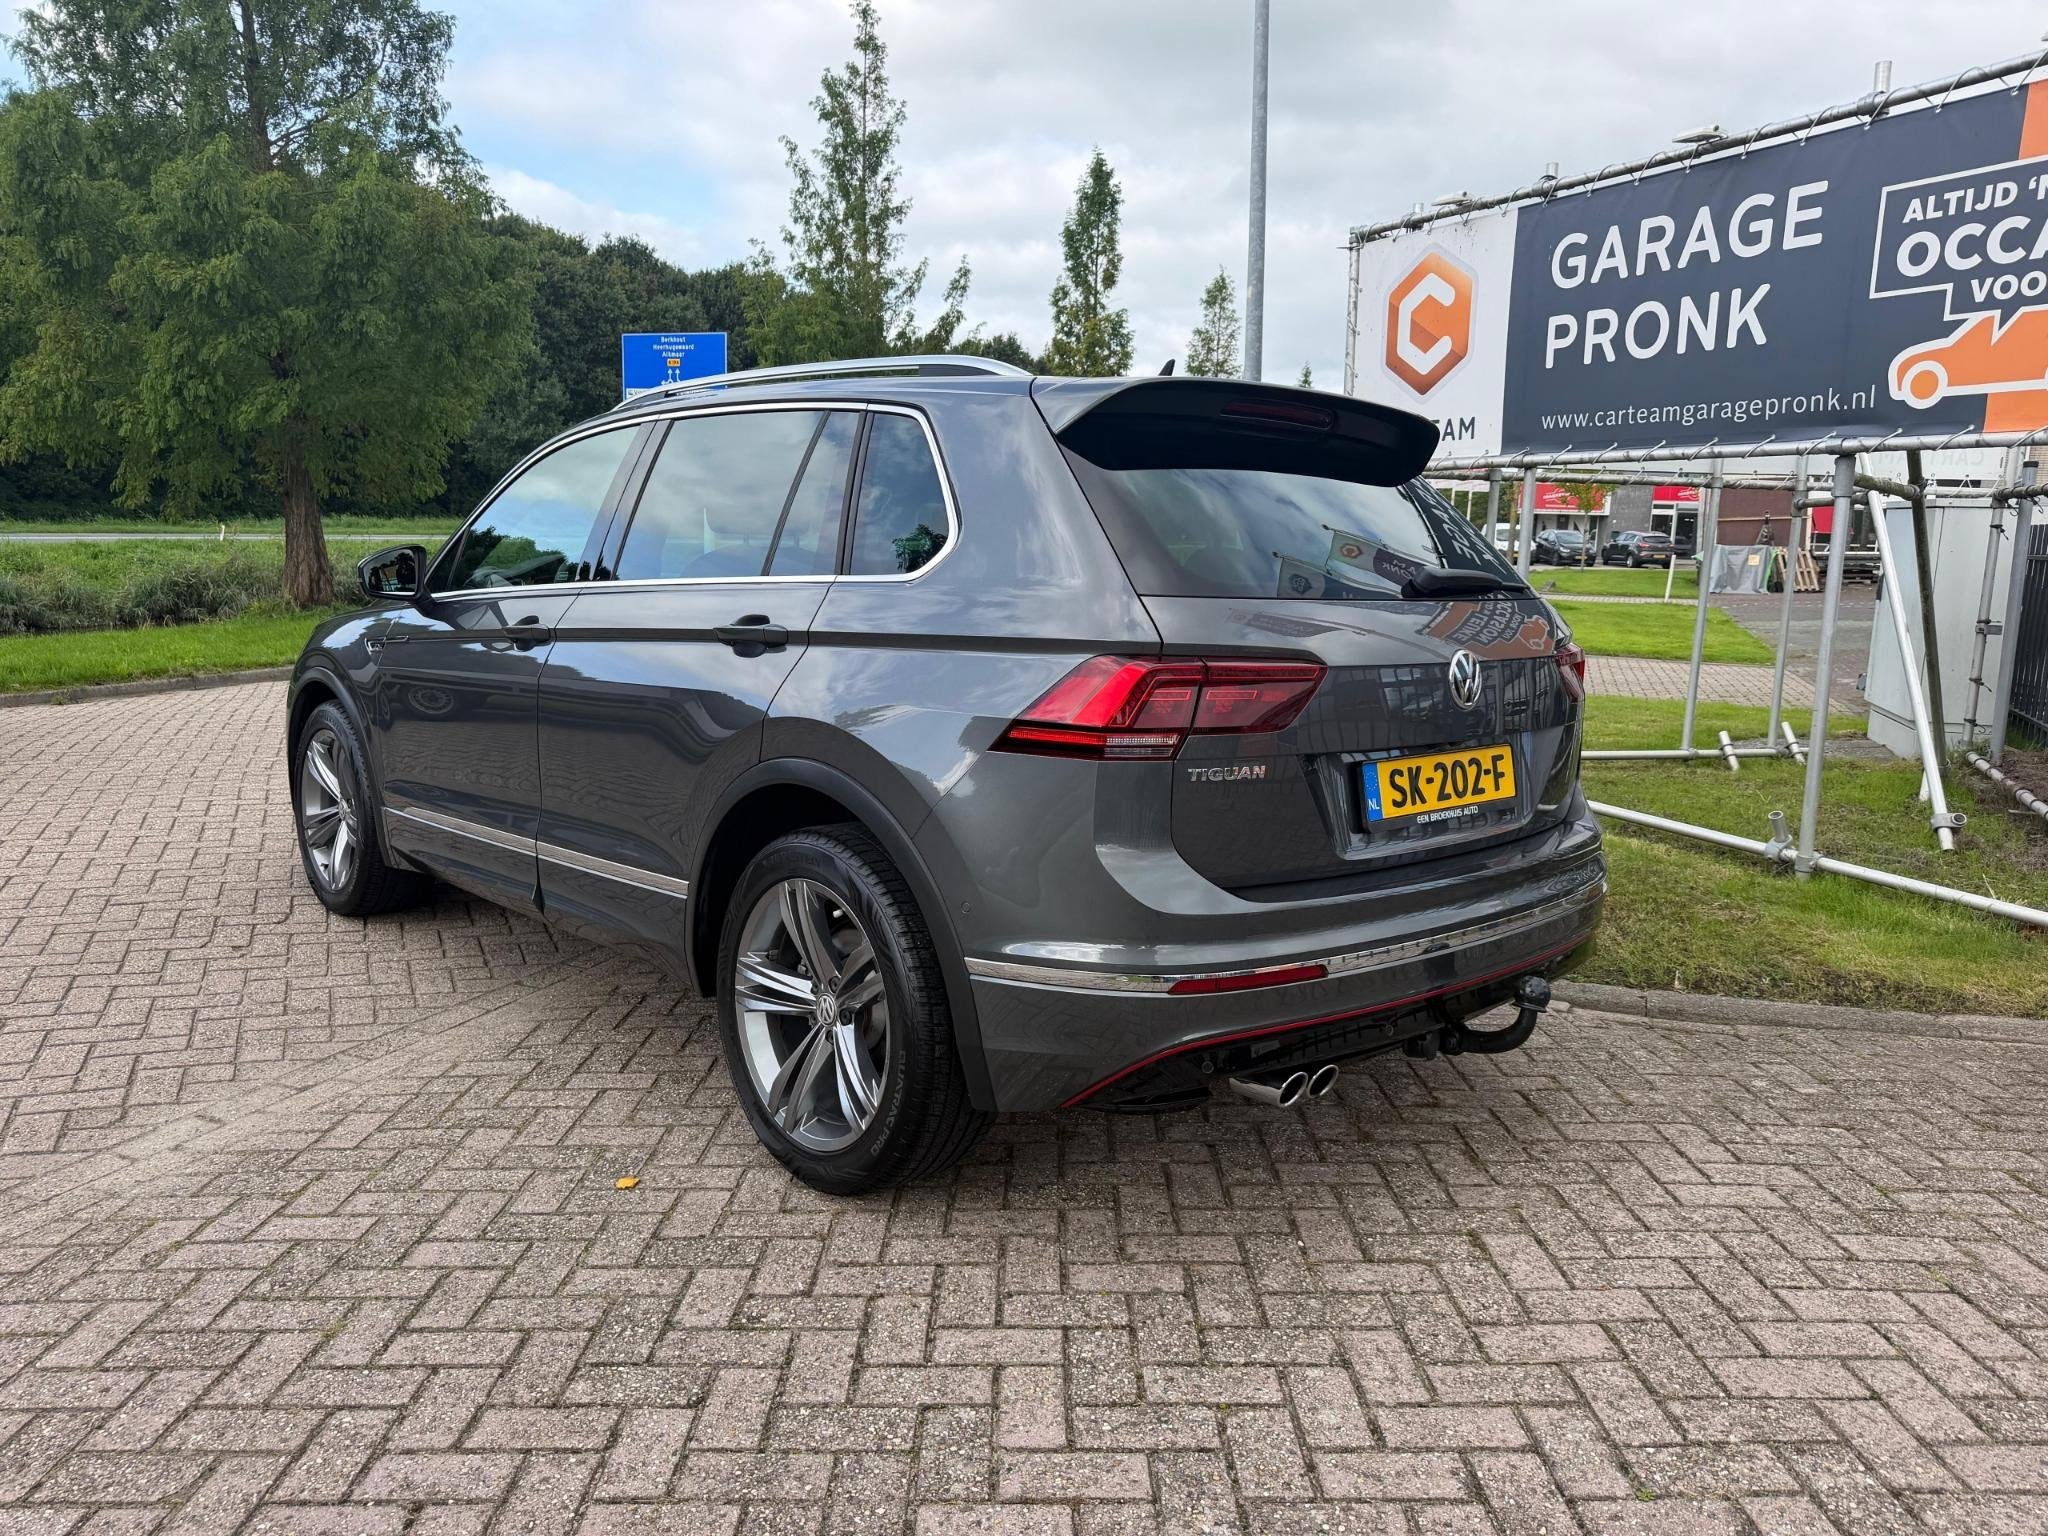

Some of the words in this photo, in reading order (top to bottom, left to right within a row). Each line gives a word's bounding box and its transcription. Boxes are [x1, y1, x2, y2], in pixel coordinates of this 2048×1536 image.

[1902, 181, 2018, 223] ALTIJD
[1551, 180, 1829, 289] GARAGE
[1545, 283, 1770, 369] PRONK
[1541, 384, 1876, 430] www.carteamgaragepronk.nl
[1187, 765, 1266, 782] TIGUAN
[1388, 754, 1506, 809] SK-202-F
[1368, 798, 1380, 810] NL
[1416, 814, 1430, 824] EEN
[1463, 805, 1479, 816] AUTO
